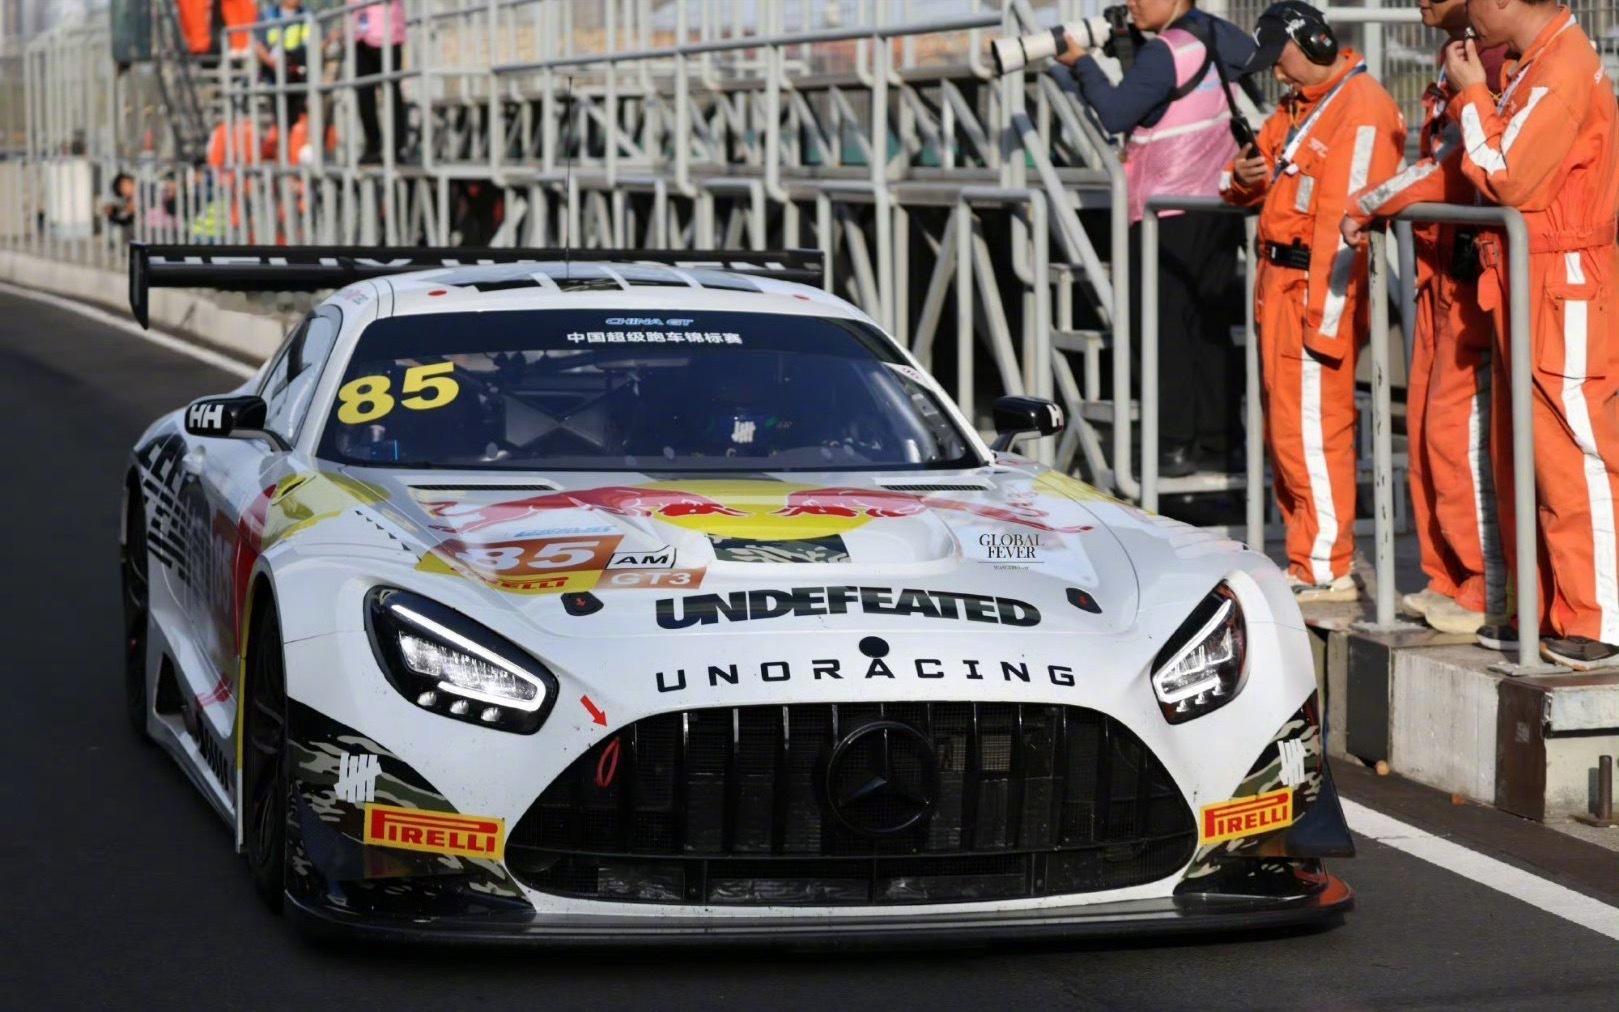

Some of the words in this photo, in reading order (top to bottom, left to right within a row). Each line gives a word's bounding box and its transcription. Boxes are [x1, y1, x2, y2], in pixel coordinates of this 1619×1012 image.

[567, 331, 743, 345] 中国超级跑车锦标赛
[337, 361, 459, 425] 85
[189, 403, 224, 429] HH
[979, 533, 1041, 546] GLOBAL
[988, 546, 1036, 559] FEVER
[614, 553, 669, 565] AM
[611, 572, 690, 585] GT3
[656, 586, 1042, 629] UNDEFEATED
[656, 658, 1076, 693] UNORACING
[1204, 792, 1289, 838] PIRELLI
[371, 809, 498, 853] PIRELLI
